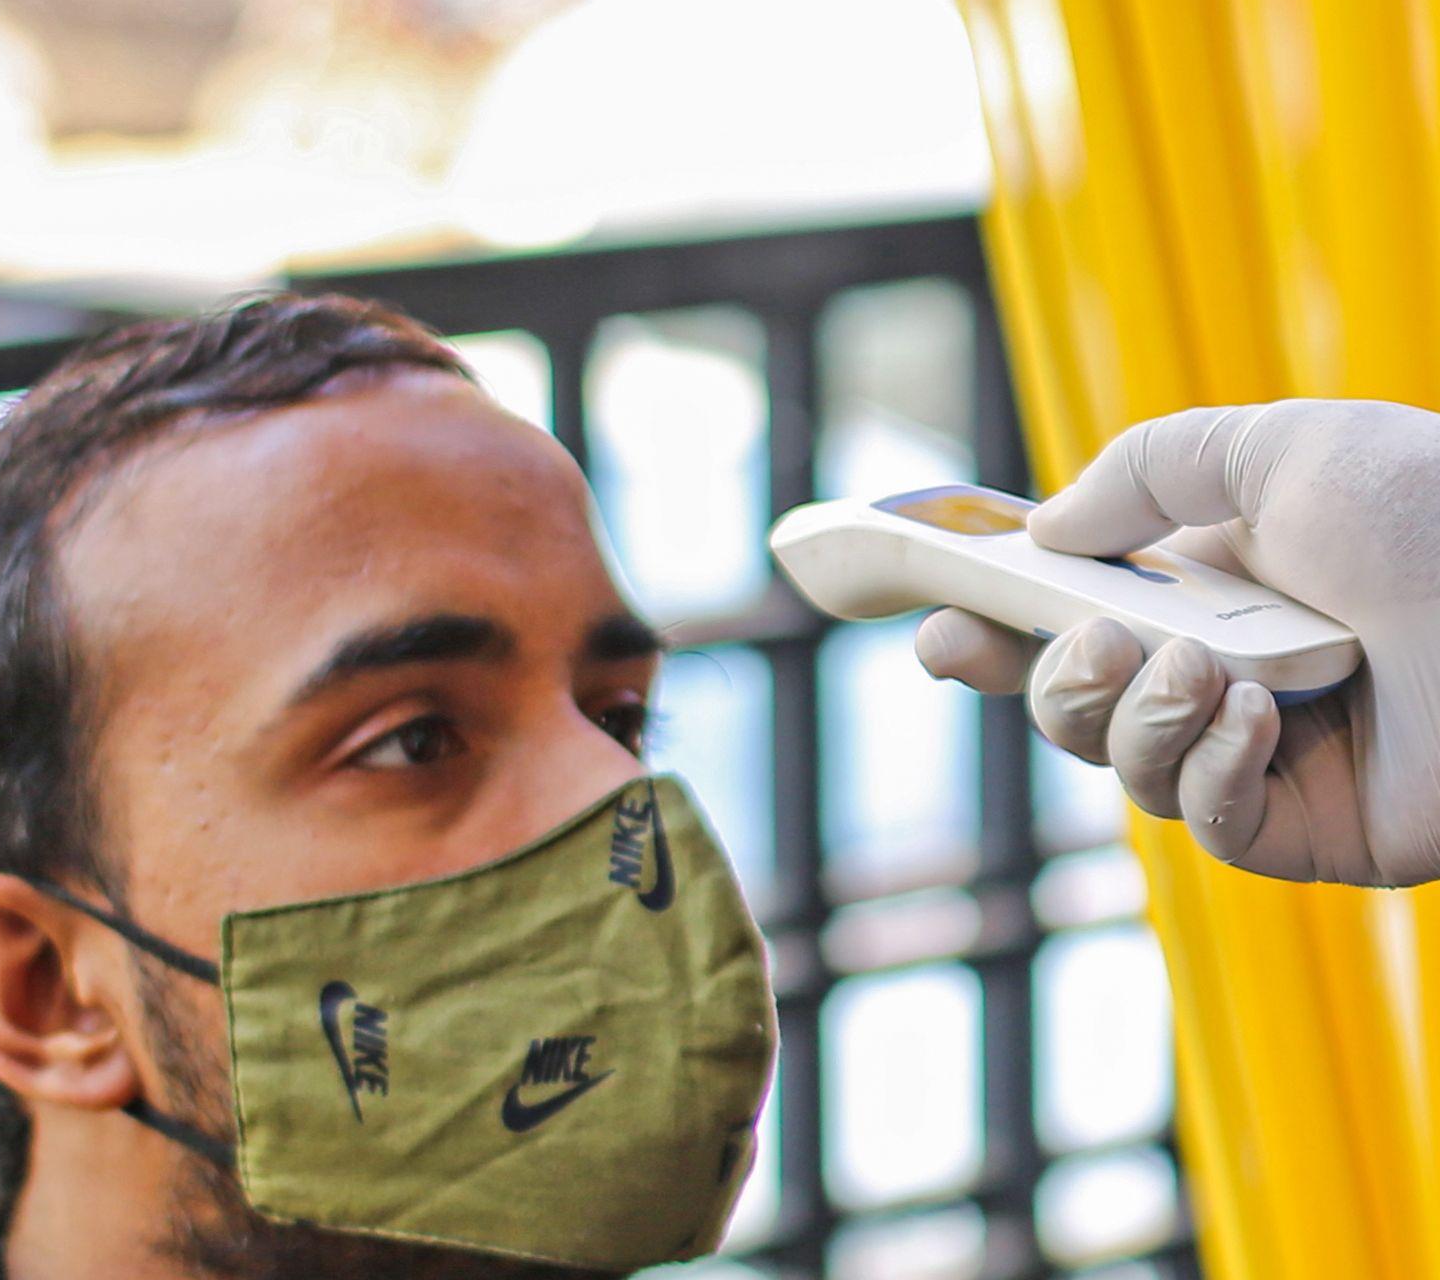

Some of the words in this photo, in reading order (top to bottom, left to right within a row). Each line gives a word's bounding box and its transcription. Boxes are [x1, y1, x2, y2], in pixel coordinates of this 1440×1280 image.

[609, 794, 653, 888] NIKE
[354, 1002, 389, 1097] NIKE
[521, 1035, 596, 1086] NIKE
